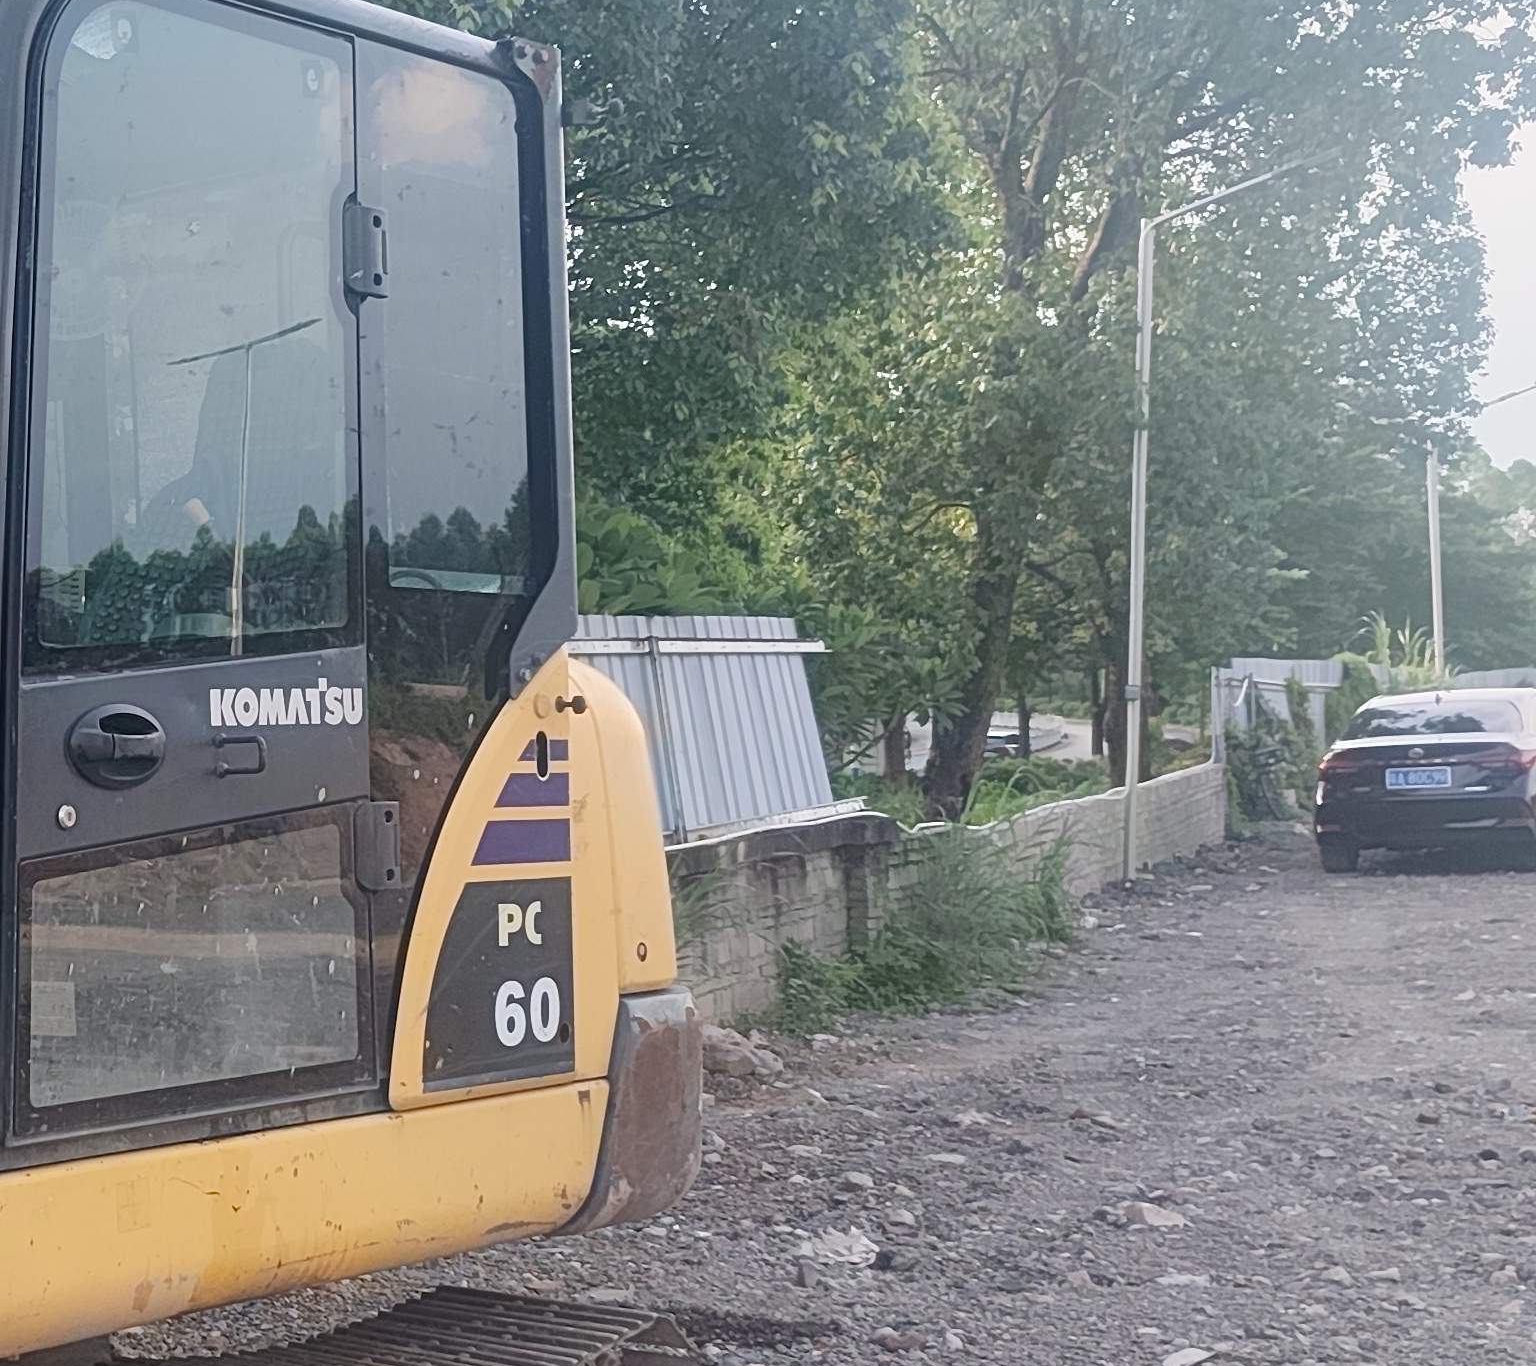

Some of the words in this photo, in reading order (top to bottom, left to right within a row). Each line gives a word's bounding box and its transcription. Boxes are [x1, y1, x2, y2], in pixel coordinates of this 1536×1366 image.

[209, 677, 364, 727] KOMATSU
[497, 900, 543, 947] PC
[494, 976, 561, 1047] 60
